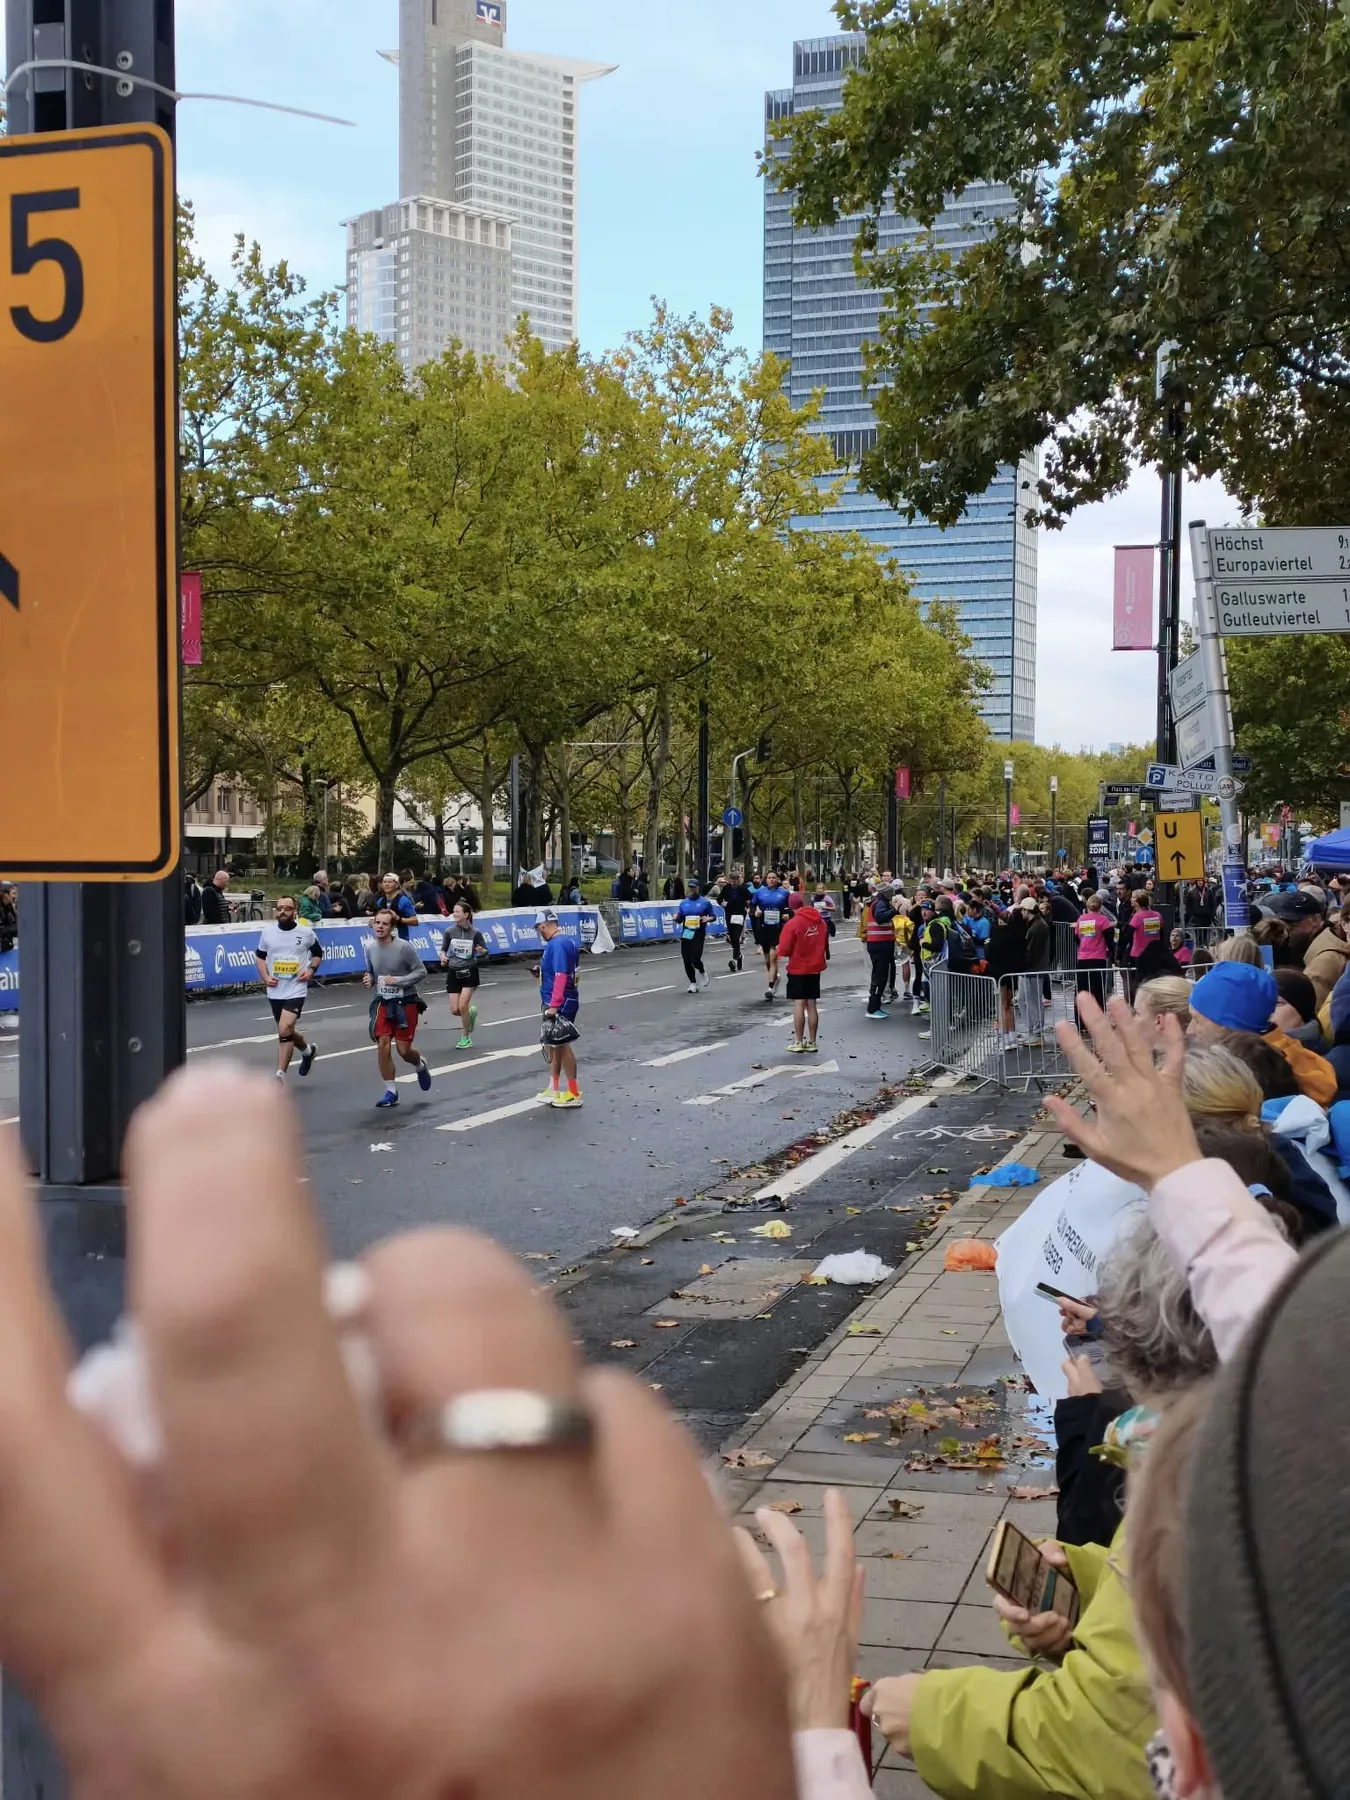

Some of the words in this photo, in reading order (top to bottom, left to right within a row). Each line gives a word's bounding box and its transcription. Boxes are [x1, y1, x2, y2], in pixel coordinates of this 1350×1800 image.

[10, 187, 84, 343] 5
[1214, 536, 1264, 551] Höchst
[1216, 556, 1313, 575] Europaviertel
[1221, 591, 1306, 606] Galluswarte
[1223, 609, 1321, 627] Gutleutviertel
[1176, 780, 1213, 791] POLLUX
[1163, 821, 1177, 838] U
[1089, 846, 1109, 854] ZONE
[1062, 1224, 1096, 1274] PREMIUM
